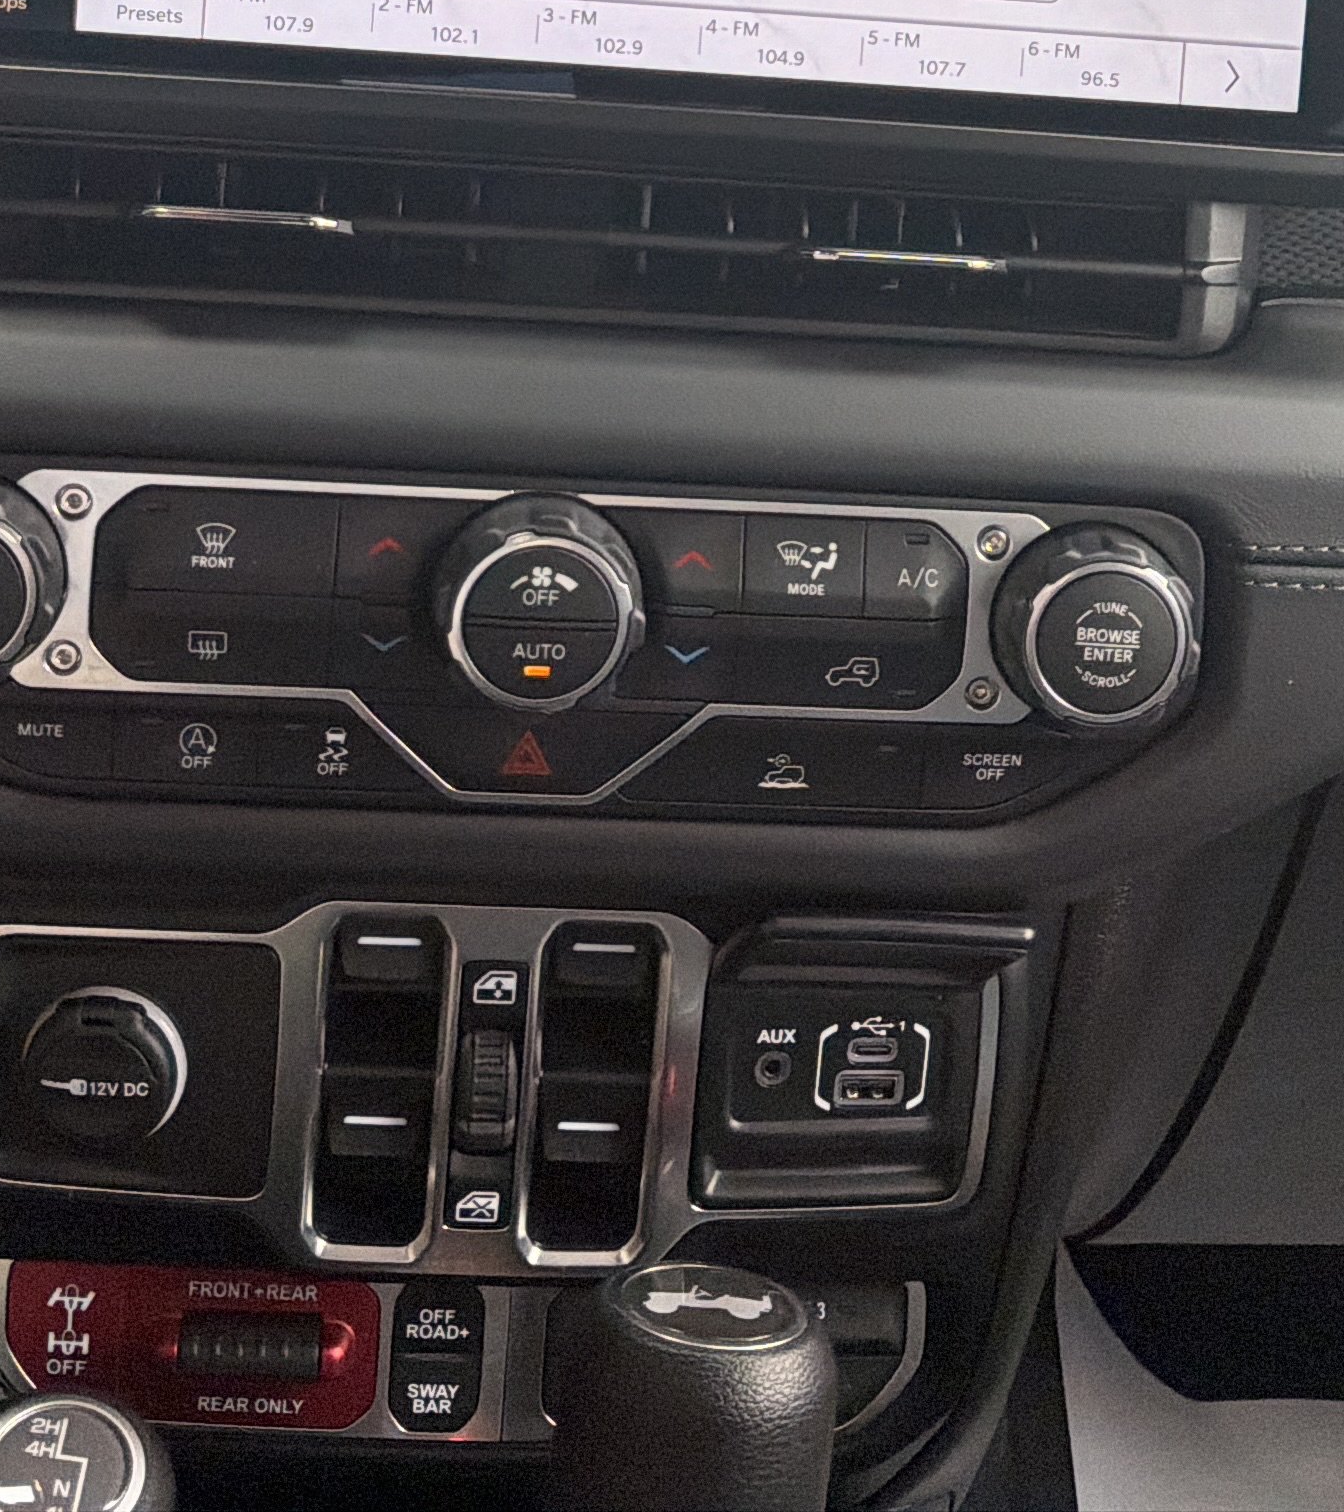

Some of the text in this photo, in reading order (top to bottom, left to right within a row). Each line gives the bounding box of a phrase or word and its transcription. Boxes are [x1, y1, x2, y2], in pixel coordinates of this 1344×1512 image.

[116, 4, 183, 24] Presets
[264, 14, 314, 32] 107.9
[544, 8, 554, 23] 3
[570, 9, 598, 26] FM
[431, 26, 479, 45] 102.1
[706, 18, 716, 34] 4
[732, 20, 760, 37] FM
[595, 38, 644, 56] 102.9
[868, 30, 878, 47] 5
[894, 32, 920, 49] FM
[756, 48, 805, 67] 104.9
[1028, 42, 1038, 58] 6
[1054, 43, 1081, 60] FM
[918, 59, 966, 78] 107.7
[1080, 70, 1120, 88] 96.5
[192, 556, 236, 570] FRONT
[897, 569, 939, 589] A/C
[522, 589, 560, 606] OFF
[787, 582, 826, 597] MODE
[1094, 602, 1128, 617] TUNE
[1076, 626, 1140, 645] BROWSE
[512, 643, 566, 661] AUTO
[1084, 647, 1134, 664] ENTER
[1081, 670, 1130, 688] SCROLL
[17, 722, 64, 738] MUTE
[181, 756, 213, 770] OFF
[317, 762, 349, 776] OFF
[963, 754, 1022, 768] SCREEN
[976, 768, 1005, 782] OFF
[757, 1029, 796, 1044] AUX
[90, 1082, 149, 1098] 12V DC
[419, 1309, 456, 1325] OFF
[816, 1302, 826, 1320] 3
[406, 1324, 470, 1340] ROAD+
[46, 1360, 87, 1376] OFF
[406, 1384, 459, 1400] SWAY
[198, 1396, 304, 1416] REAR ONLY
[412, 1399, 452, 1414] BAR
[30, 1418, 61, 1436] 2H
[24, 1440, 56, 1459] 4H
[52, 1478, 71, 1498] N
